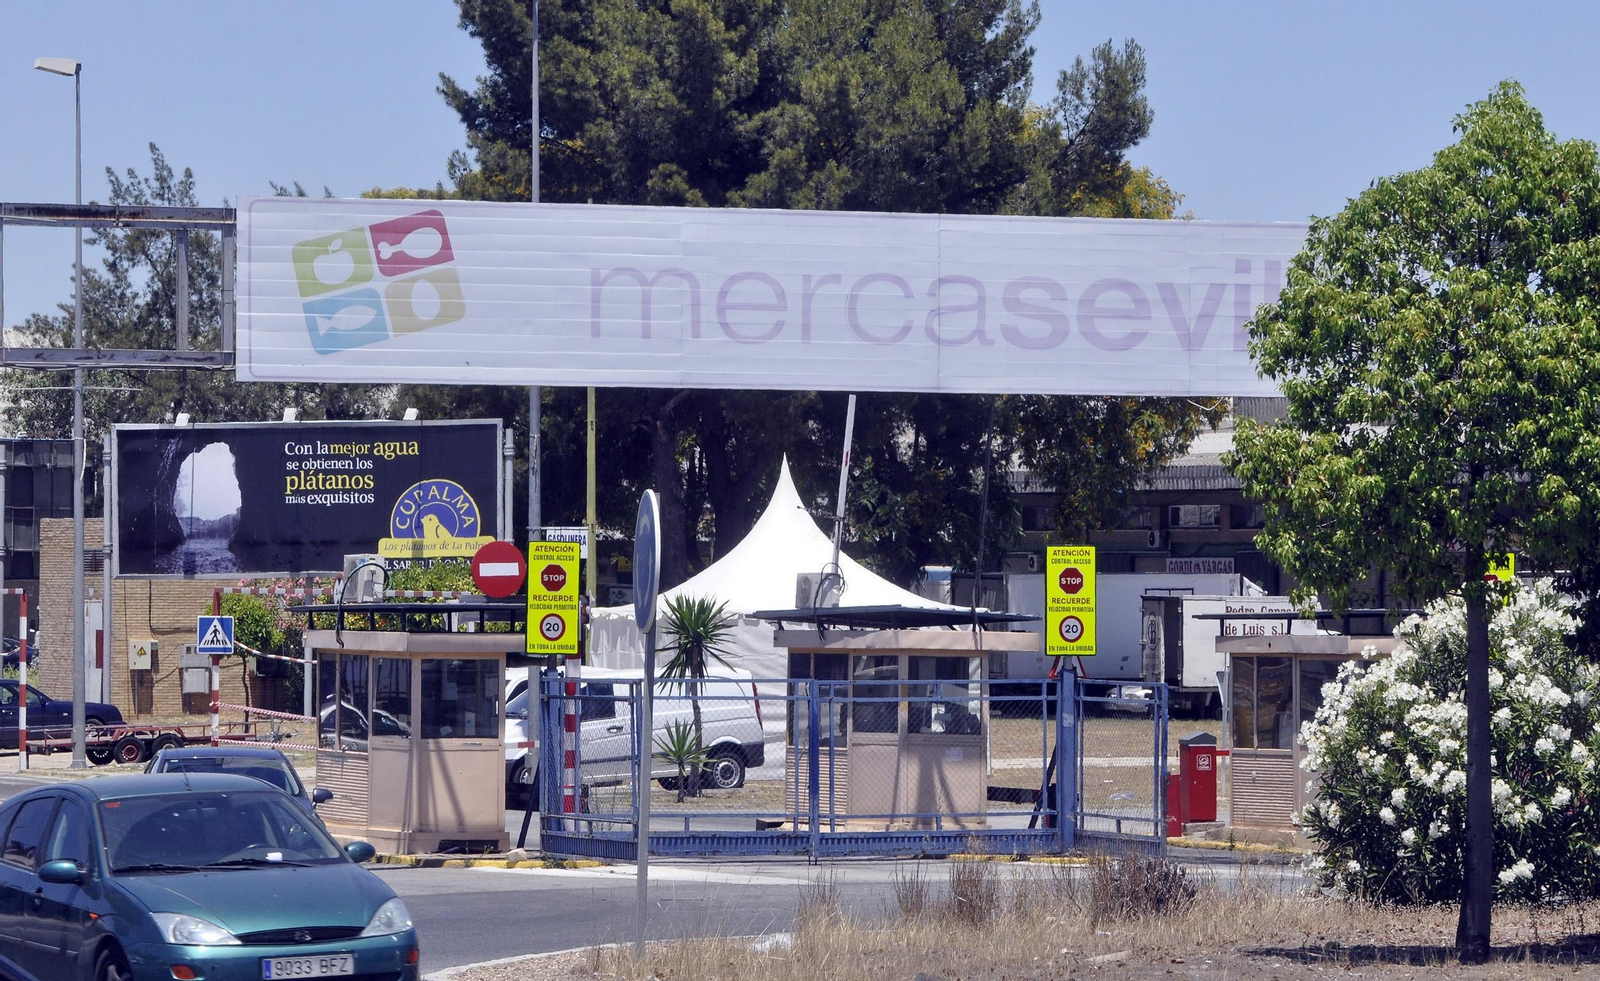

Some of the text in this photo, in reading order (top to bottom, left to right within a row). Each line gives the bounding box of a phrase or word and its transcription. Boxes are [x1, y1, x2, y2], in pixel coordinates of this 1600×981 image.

[285, 441, 419, 460] Con la mejor agua
[286, 458, 373, 470] se obtienen los
[285, 470, 375, 494] plátanos
[285, 491, 375, 506] más exquisitos
[384, 542, 397, 551] Los
[440, 540, 450, 550] de
[452, 541, 463, 550] La
[465, 541, 484, 550] Pal
[534, 545, 574, 553] ATENCIÓN
[1052, 548, 1091, 557] ATENCIÓN
[556, 554, 575, 562] ACCESO
[393, 560, 425, 569] SABR
[1201, 560, 1233, 574] VARGAS
[543, 574, 565, 582] STOP
[1060, 577, 1082, 585] STOP
[545, 622, 560, 632] 20
[1064, 624, 1079, 634] 20
[1225, 623, 1238, 635] de
[1242, 623, 1265, 636] Luis
[275, 957, 348, 976] 9033 BFZ
